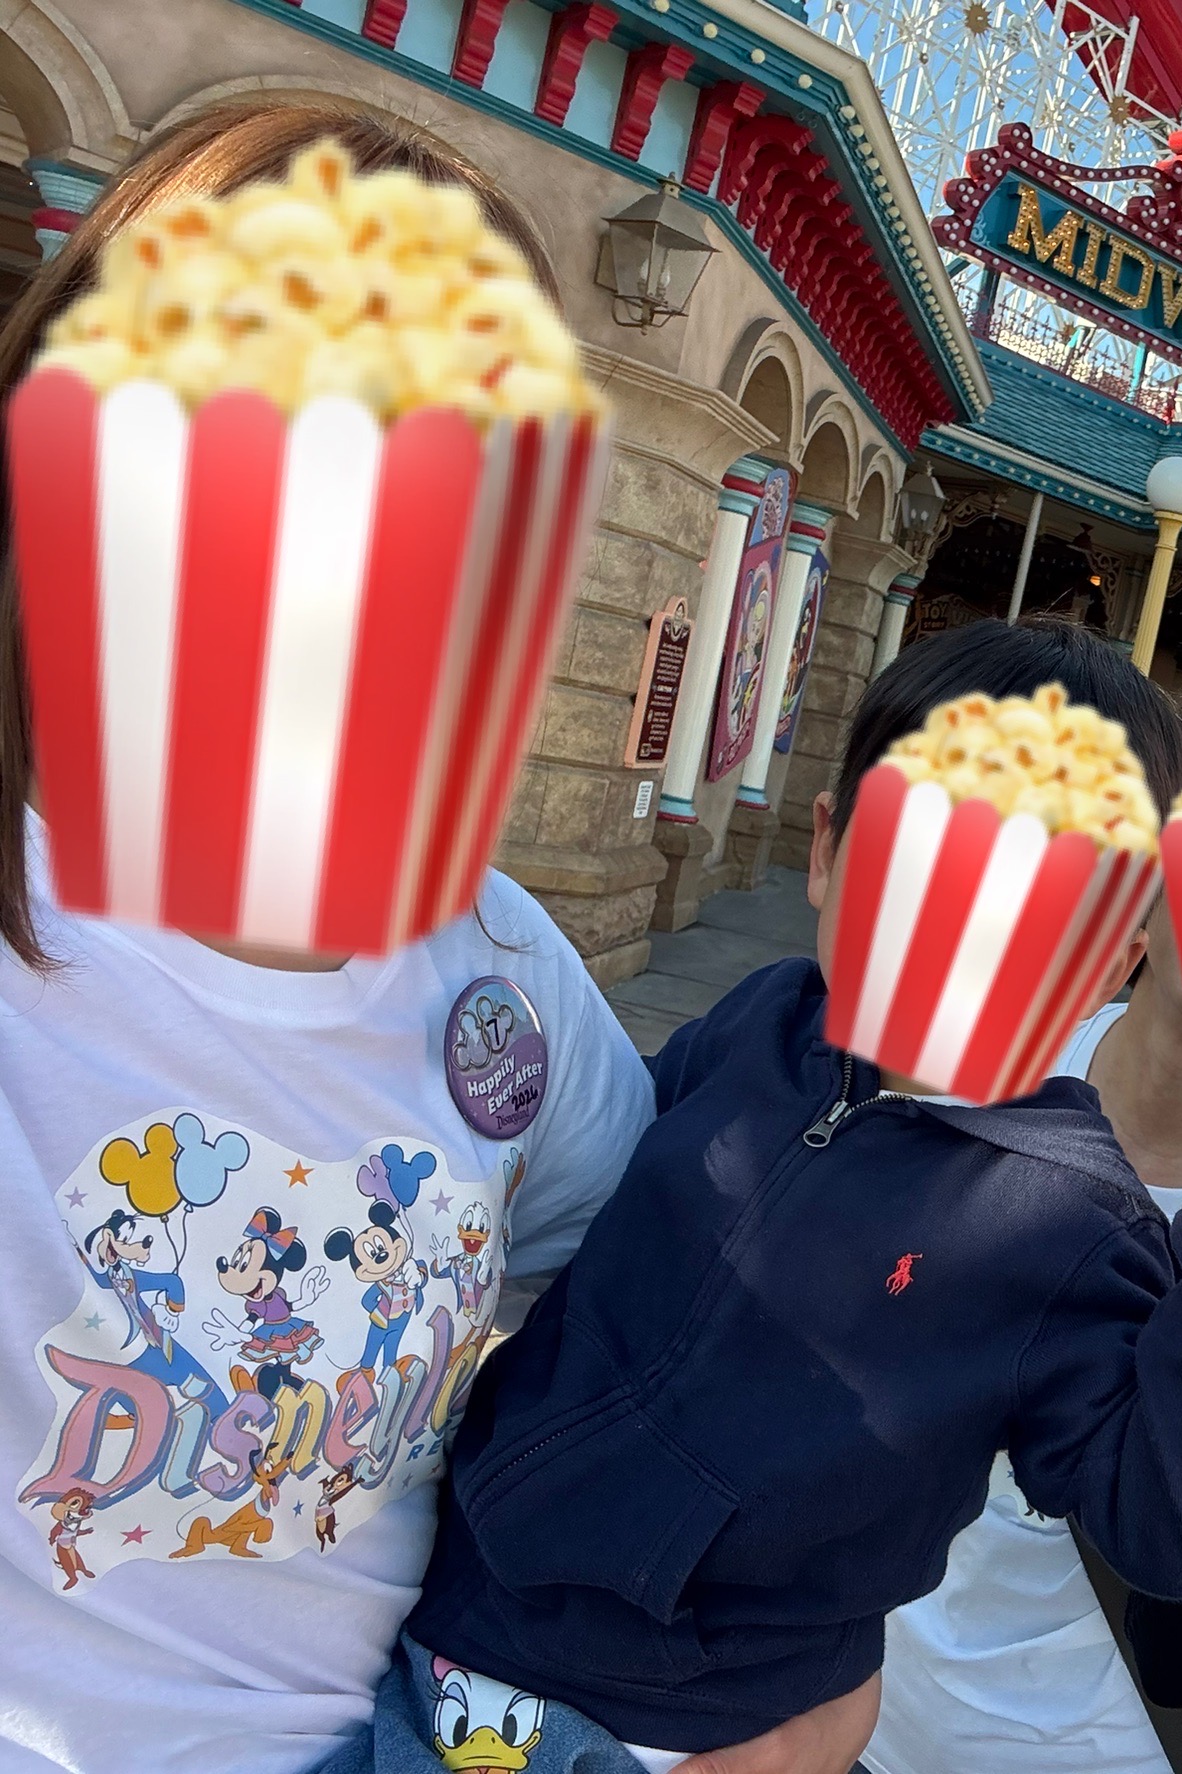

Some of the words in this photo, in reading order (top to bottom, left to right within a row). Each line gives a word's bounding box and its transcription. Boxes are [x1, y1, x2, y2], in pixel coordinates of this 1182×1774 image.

[922, 602, 948, 619] TOY
[486, 1017, 501, 1046] 7
[467, 1053, 516, 1098] Happily
[487, 1082, 513, 1116] Ever
[515, 1061, 543, 1089] After
[496, 1109, 530, 1130] Disneyland
[17, 1305, 478, 1513] Disneyla
